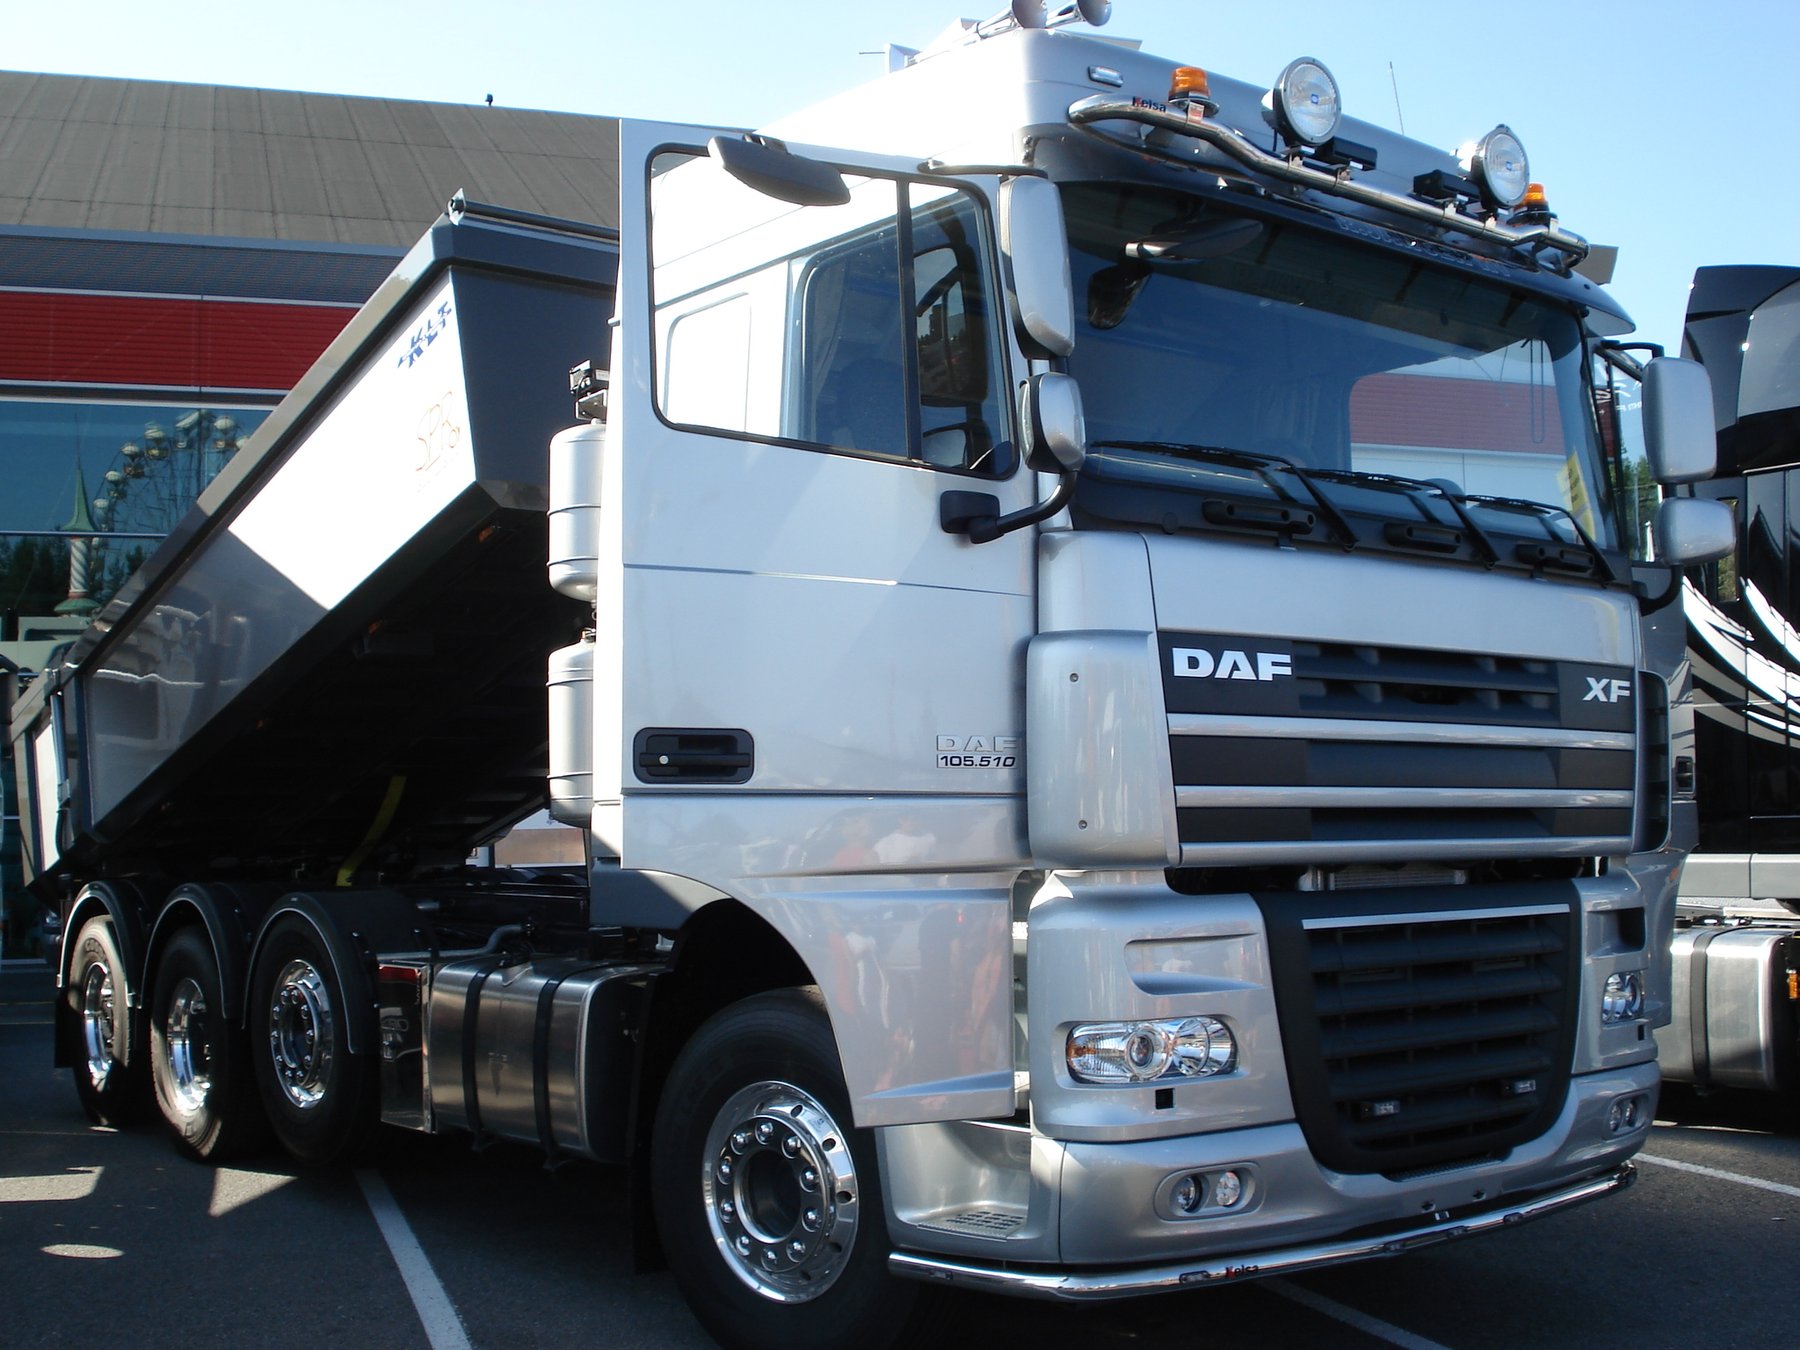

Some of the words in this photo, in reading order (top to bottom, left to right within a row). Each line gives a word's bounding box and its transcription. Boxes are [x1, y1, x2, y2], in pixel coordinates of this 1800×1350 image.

[1172, 647, 1292, 681] DAF
[1582, 676, 1631, 703] XF
[936, 734, 1018, 752] DAF
[940, 755, 1017, 768] 105.510
